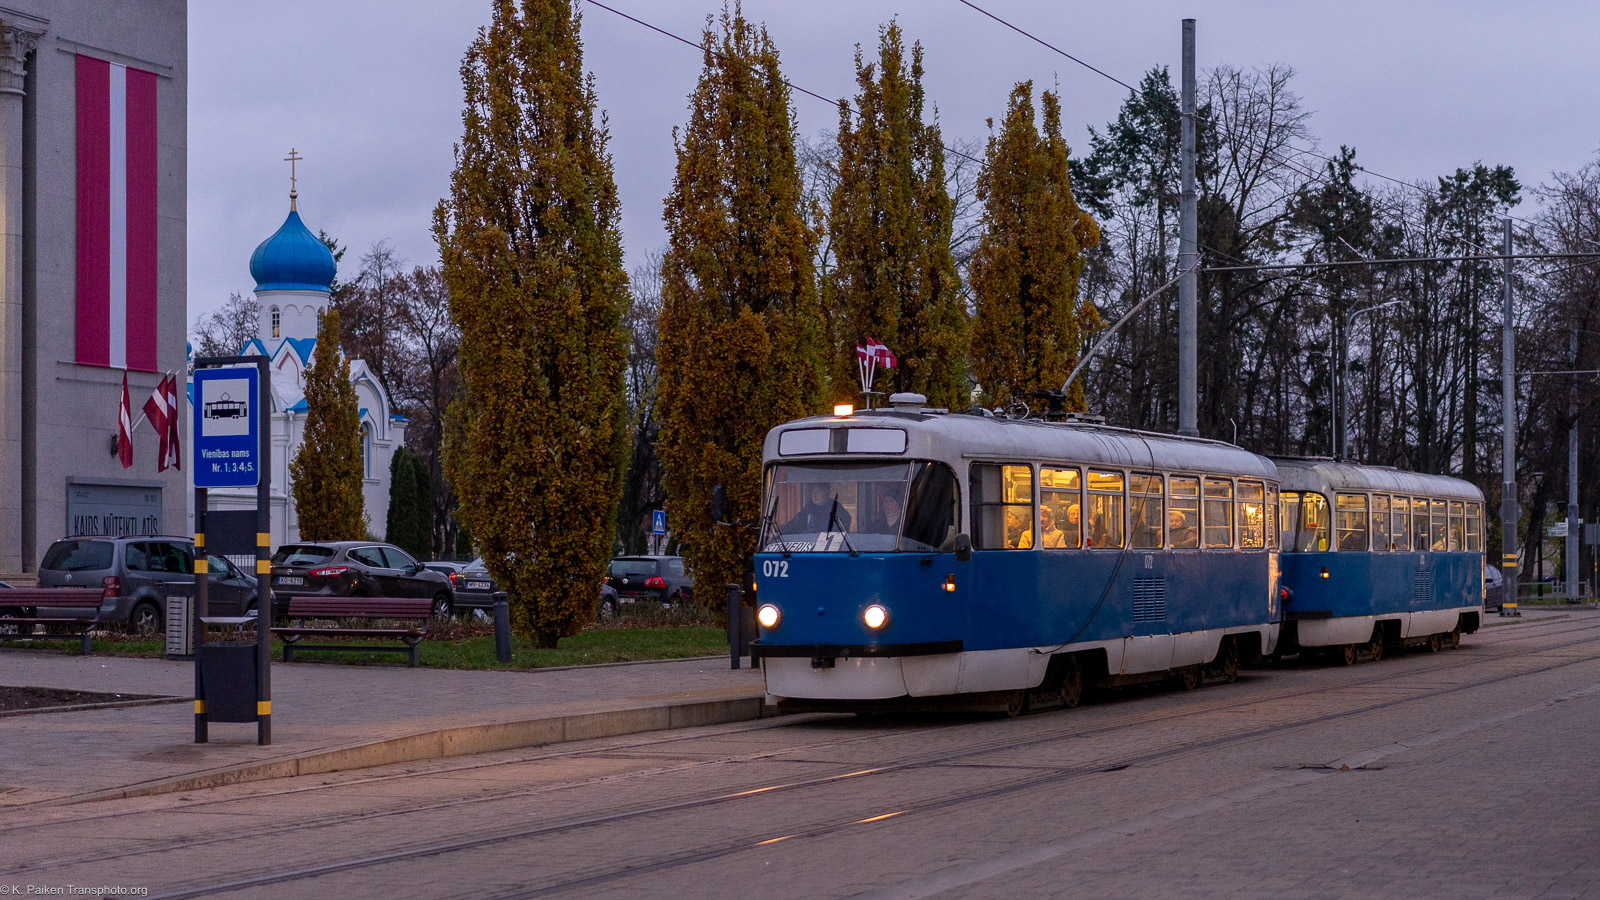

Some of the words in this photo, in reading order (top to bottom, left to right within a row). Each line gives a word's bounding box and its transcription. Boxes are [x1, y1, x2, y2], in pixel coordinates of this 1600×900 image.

[201, 449, 230, 458] Vienības
[231, 450, 250, 458] nams
[212, 463, 223, 472] Nr.
[763, 560, 789, 578] 072
